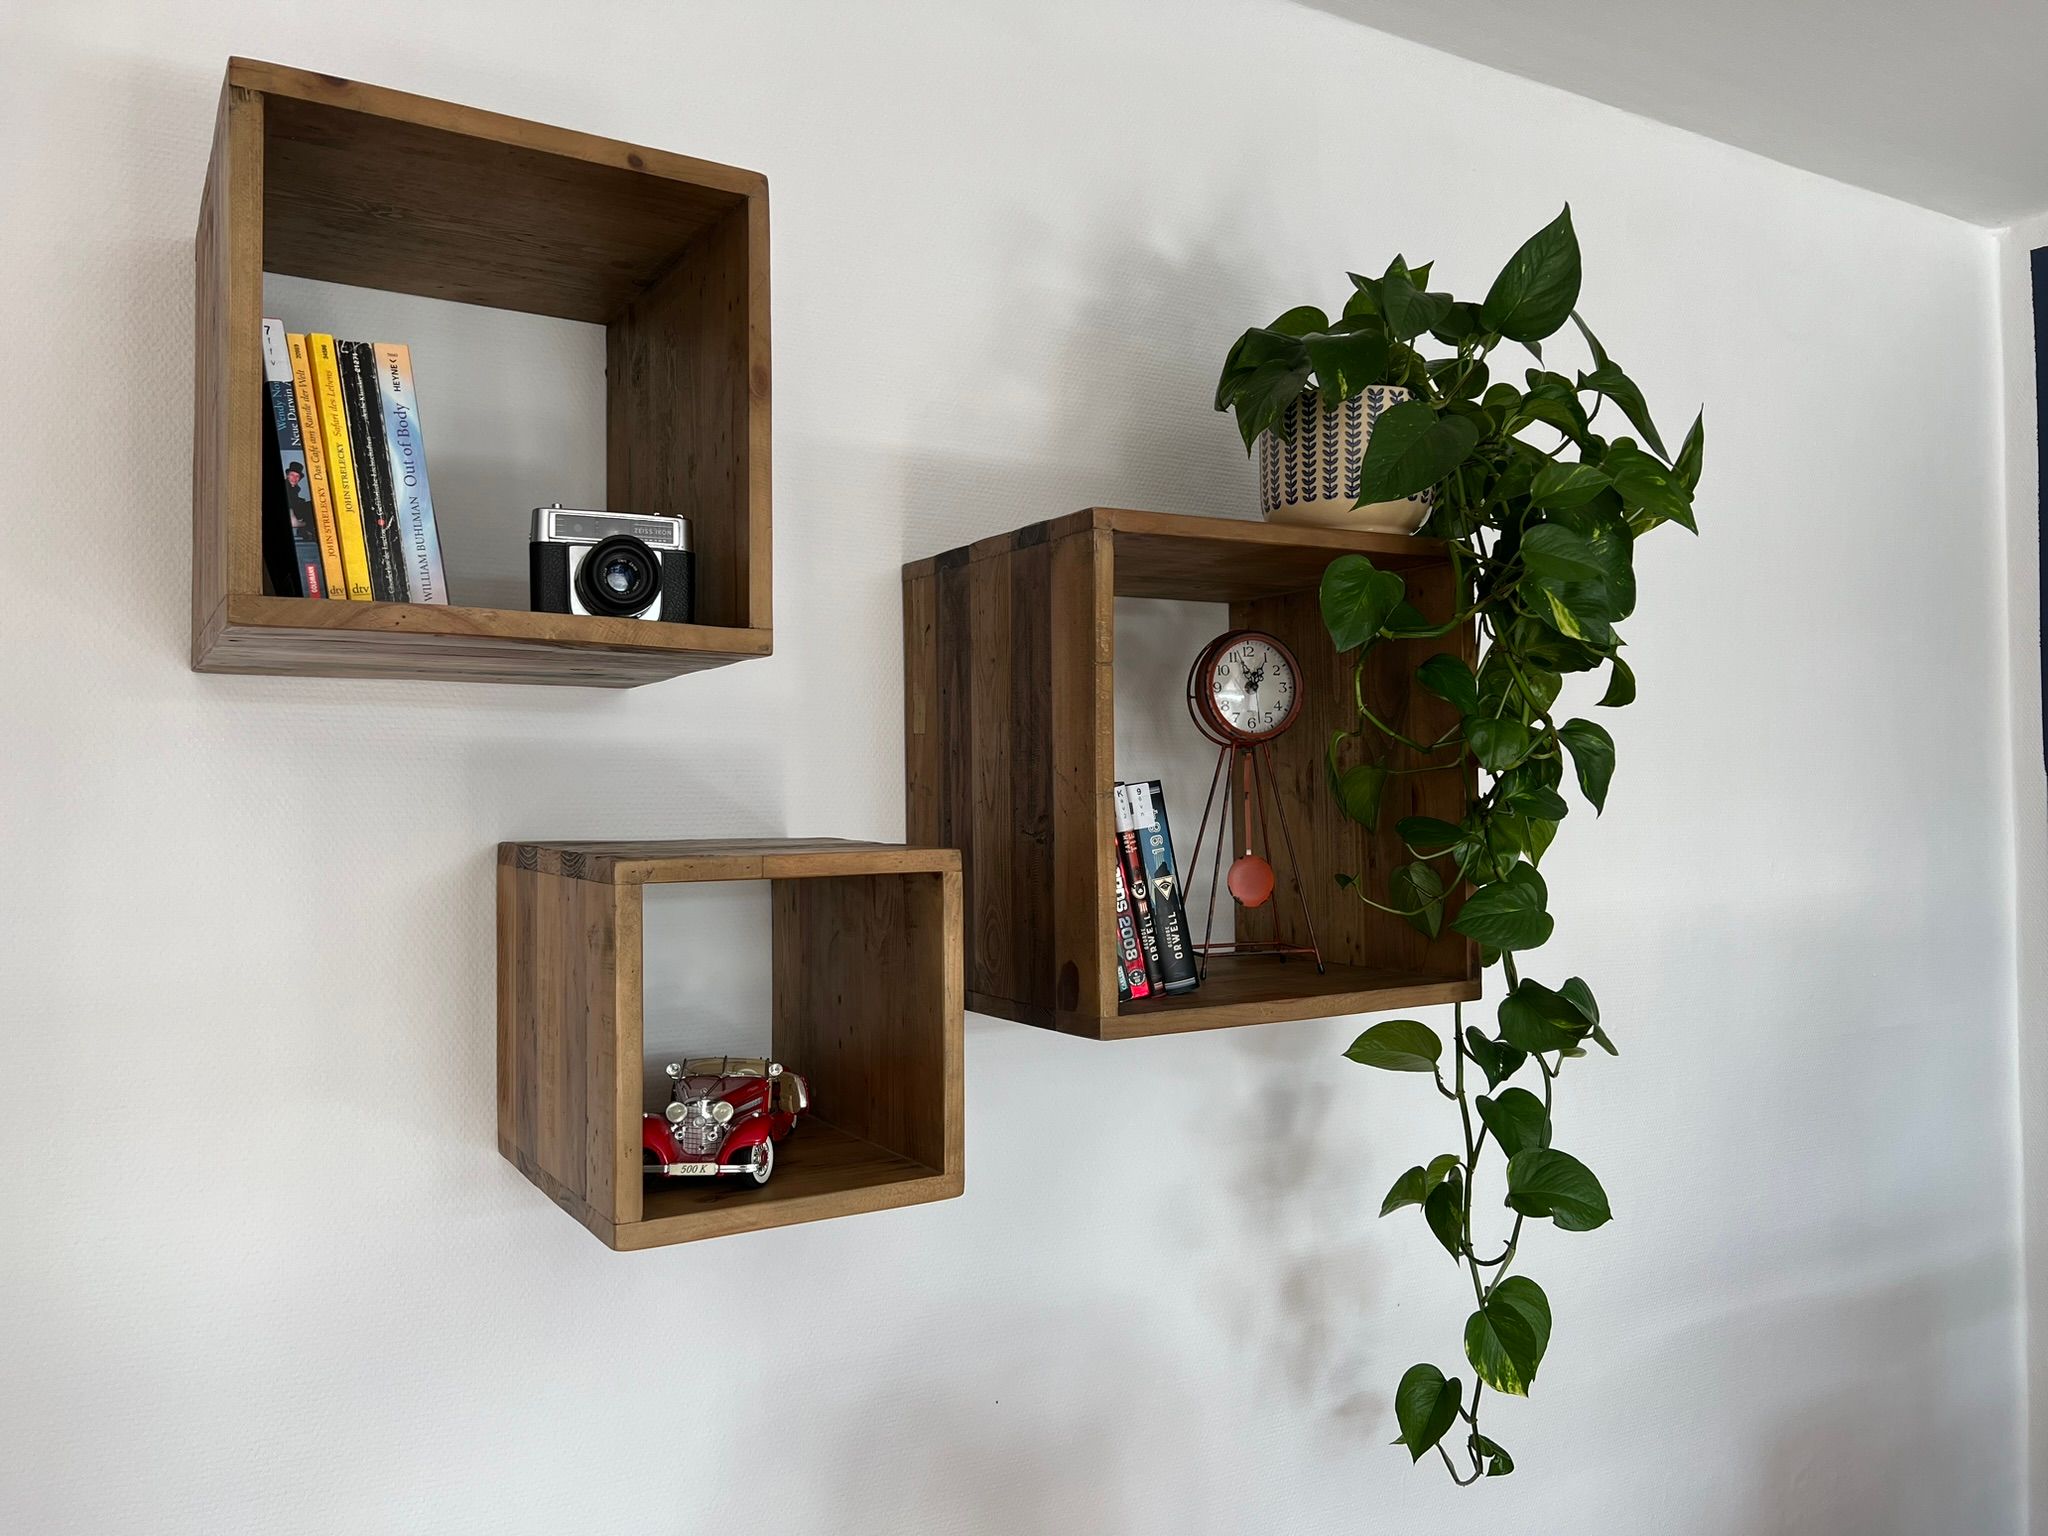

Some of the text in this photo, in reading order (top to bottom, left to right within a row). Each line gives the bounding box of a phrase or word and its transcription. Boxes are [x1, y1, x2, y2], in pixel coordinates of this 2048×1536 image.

[390, 364, 401, 392] HEYNE
[284, 388, 297, 421] Darwin
[325, 370, 343, 437] Safari des Lebens
[274, 400, 287, 431] Wendy
[296, 369, 323, 481] Das Café am Rande der Welt
[290, 423, 301, 446] Neue
[393, 402, 418, 487] Out of Body
[336, 442, 355, 513] JOHN STRELECKY
[317, 486, 338, 559] JOHN STRELECKY
[409, 496, 433, 602] WILLIAM BUHLMAN
[329, 585, 345, 595] dtv
[351, 582, 370, 595] dtv
[1229, 652, 1238, 663] 11
[1243, 646, 1255, 657] 12
[1263, 652, 1268, 663] 1
[1217, 664, 1230, 676] 10
[1272, 665, 1281, 676] 2
[1212, 681, 1222, 693] 9
[1279, 682, 1288, 693] 3
[1220, 700, 1230, 711] 8
[1274, 700, 1282, 711] 4
[1232, 712, 1241, 723] 7
[1247, 717, 1257, 729] 6
[1264, 712, 1273, 723] 5
[1118, 916, 1138, 961] 2008
[1143, 913, 1159, 962] ORWELL
[1167, 911, 1184, 960] ORWELL
[680, 1164, 708, 1174] 500 K
